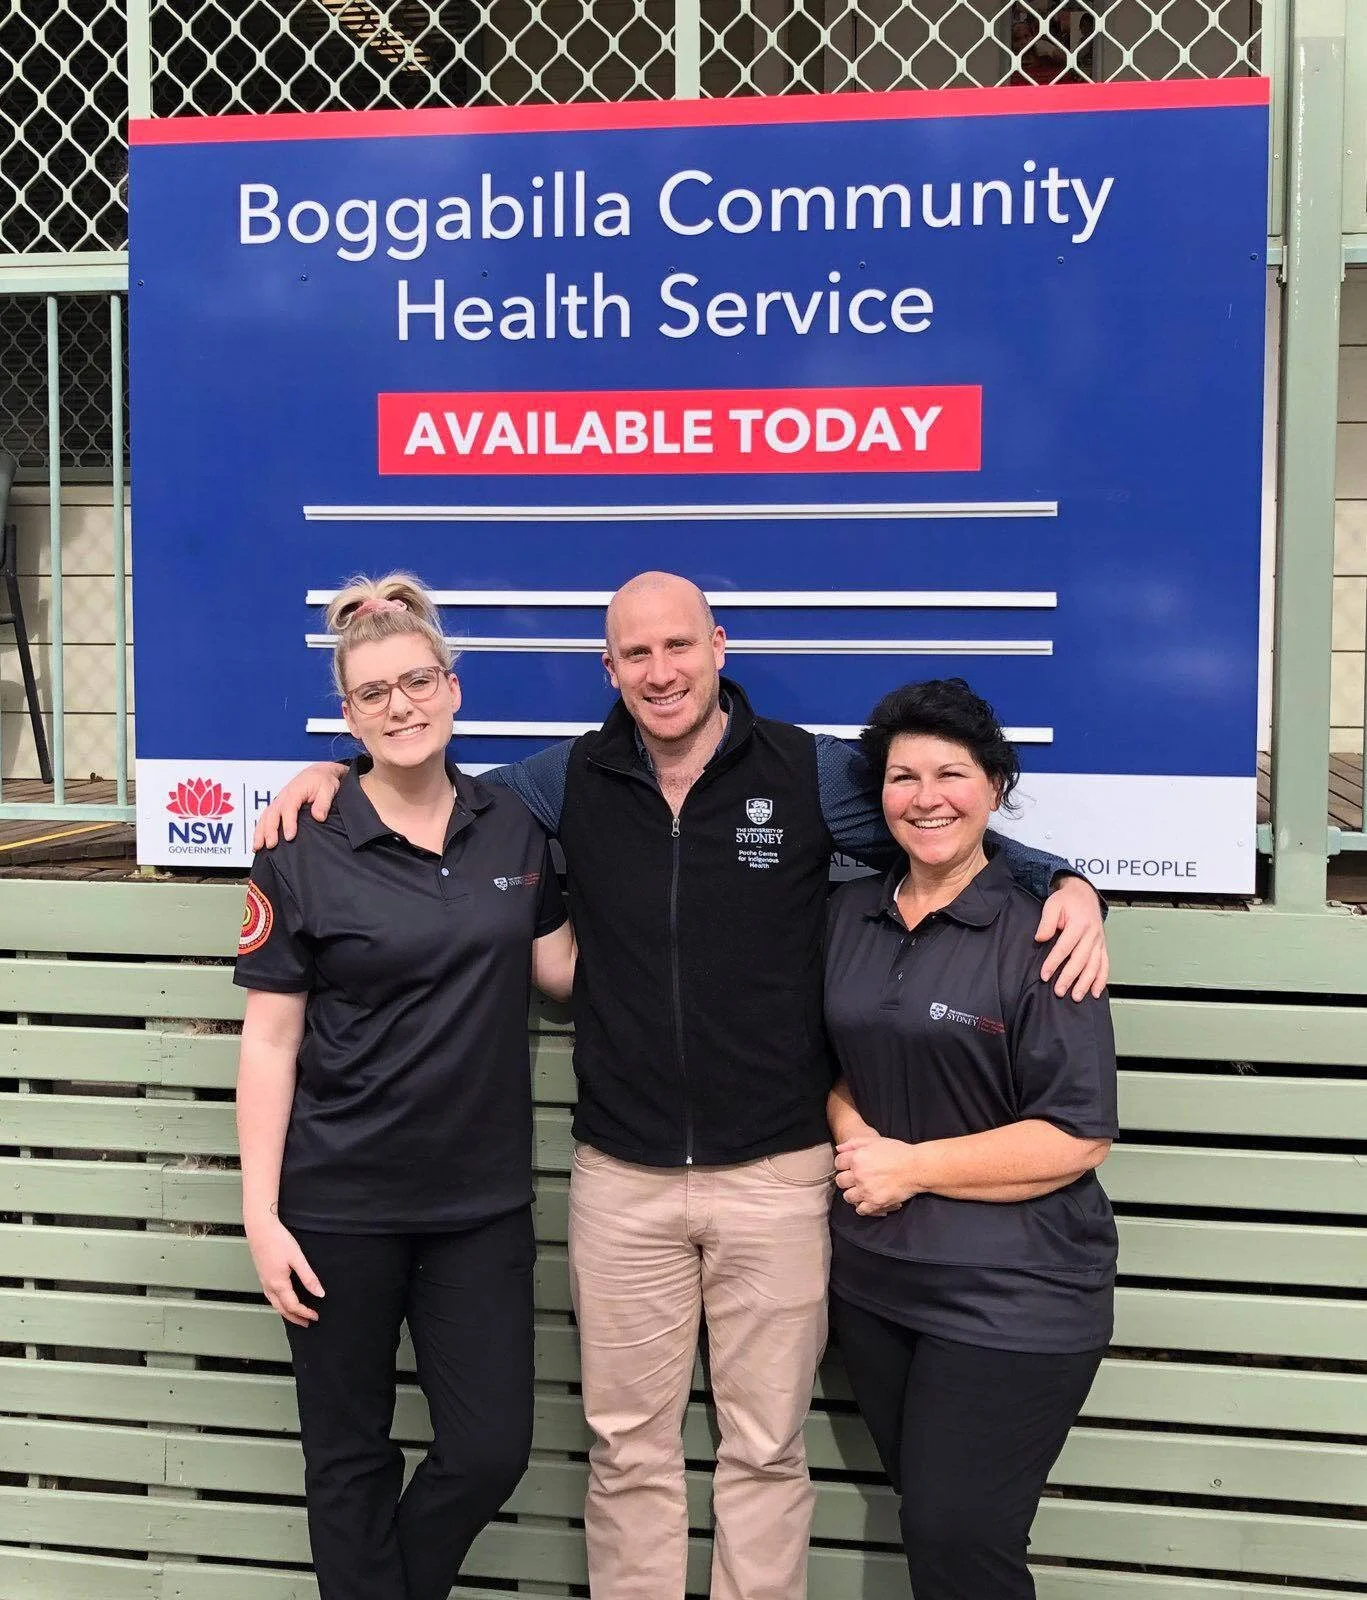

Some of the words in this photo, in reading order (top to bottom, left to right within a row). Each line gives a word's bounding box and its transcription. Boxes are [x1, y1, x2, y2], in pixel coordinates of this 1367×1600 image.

[239, 170, 631, 263] Boggabilla
[658, 159, 1115, 245] Community
[396, 272, 631, 342] Health
[658, 271, 935, 340] Service
[404, 410, 713, 456] AVAILABLE
[728, 406, 942, 454] TODAY
[168, 821, 234, 845] NSW
[735, 832, 784, 844] SYDNEY
[168, 846, 233, 855] GOVERNMENT
[1117, 859, 1198, 878] PEOPLE
